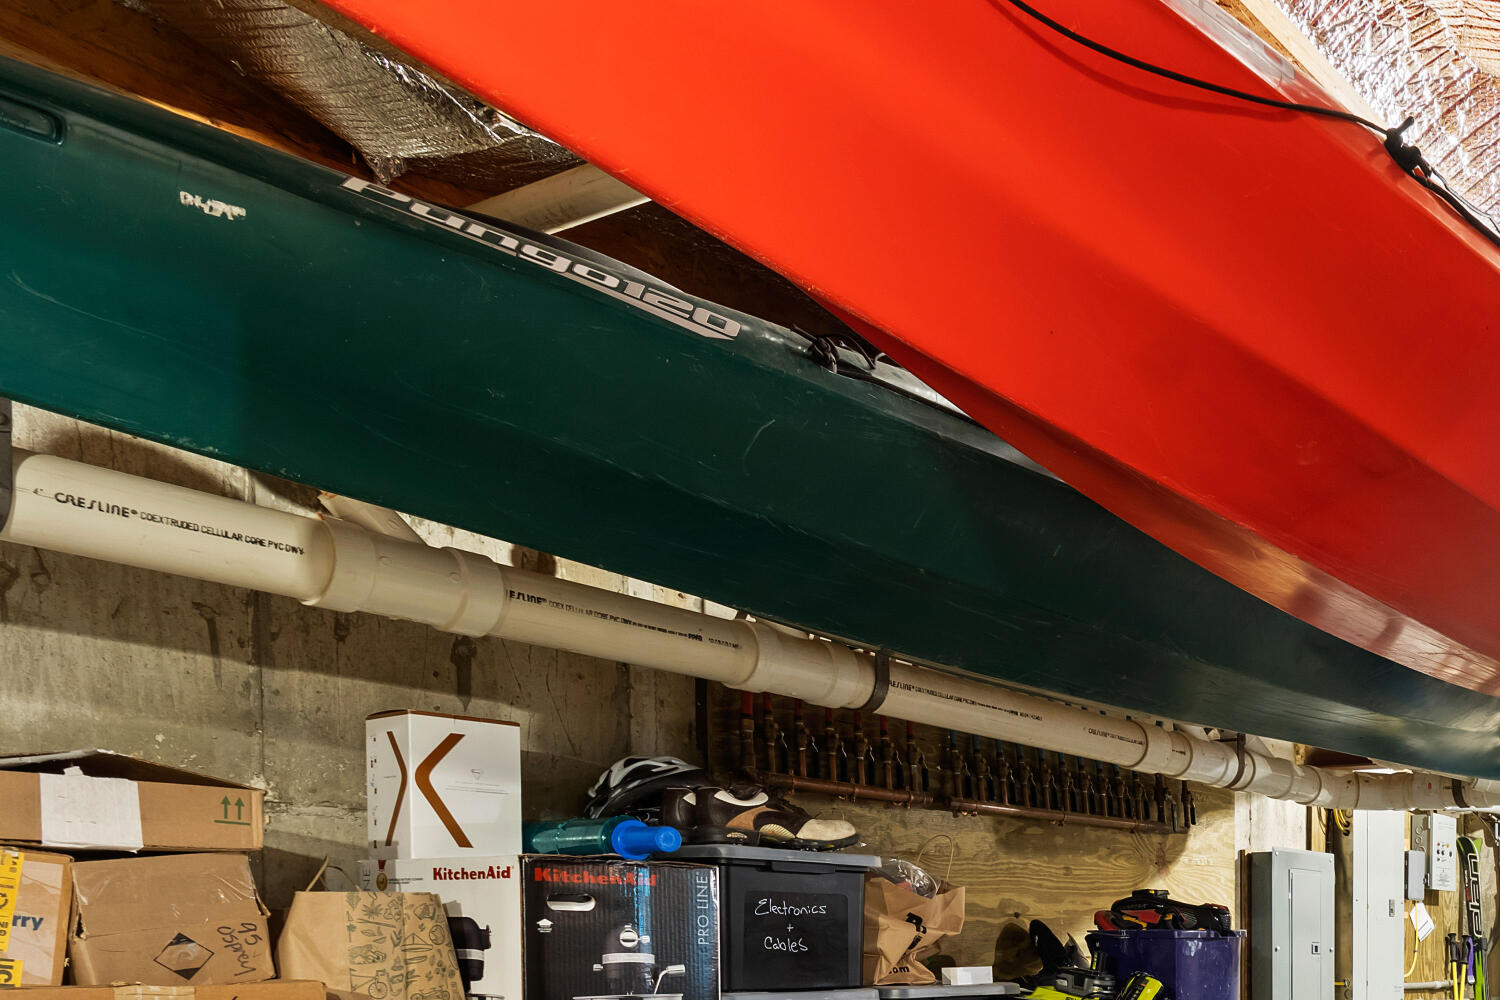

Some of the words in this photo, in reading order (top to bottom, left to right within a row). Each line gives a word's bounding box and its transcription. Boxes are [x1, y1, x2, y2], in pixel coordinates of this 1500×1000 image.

[201, 524, 243, 542] CELLULAR
[244, 535, 266, 547] CORE
[433, 866, 511, 881] KitchenAid
[534, 867, 657, 886] KitchenAid
[697, 876, 709, 910] LINE
[754, 898, 828, 917] Electronics
[697, 916, 711, 946] PRO
[764, 936, 809, 953] Cables
